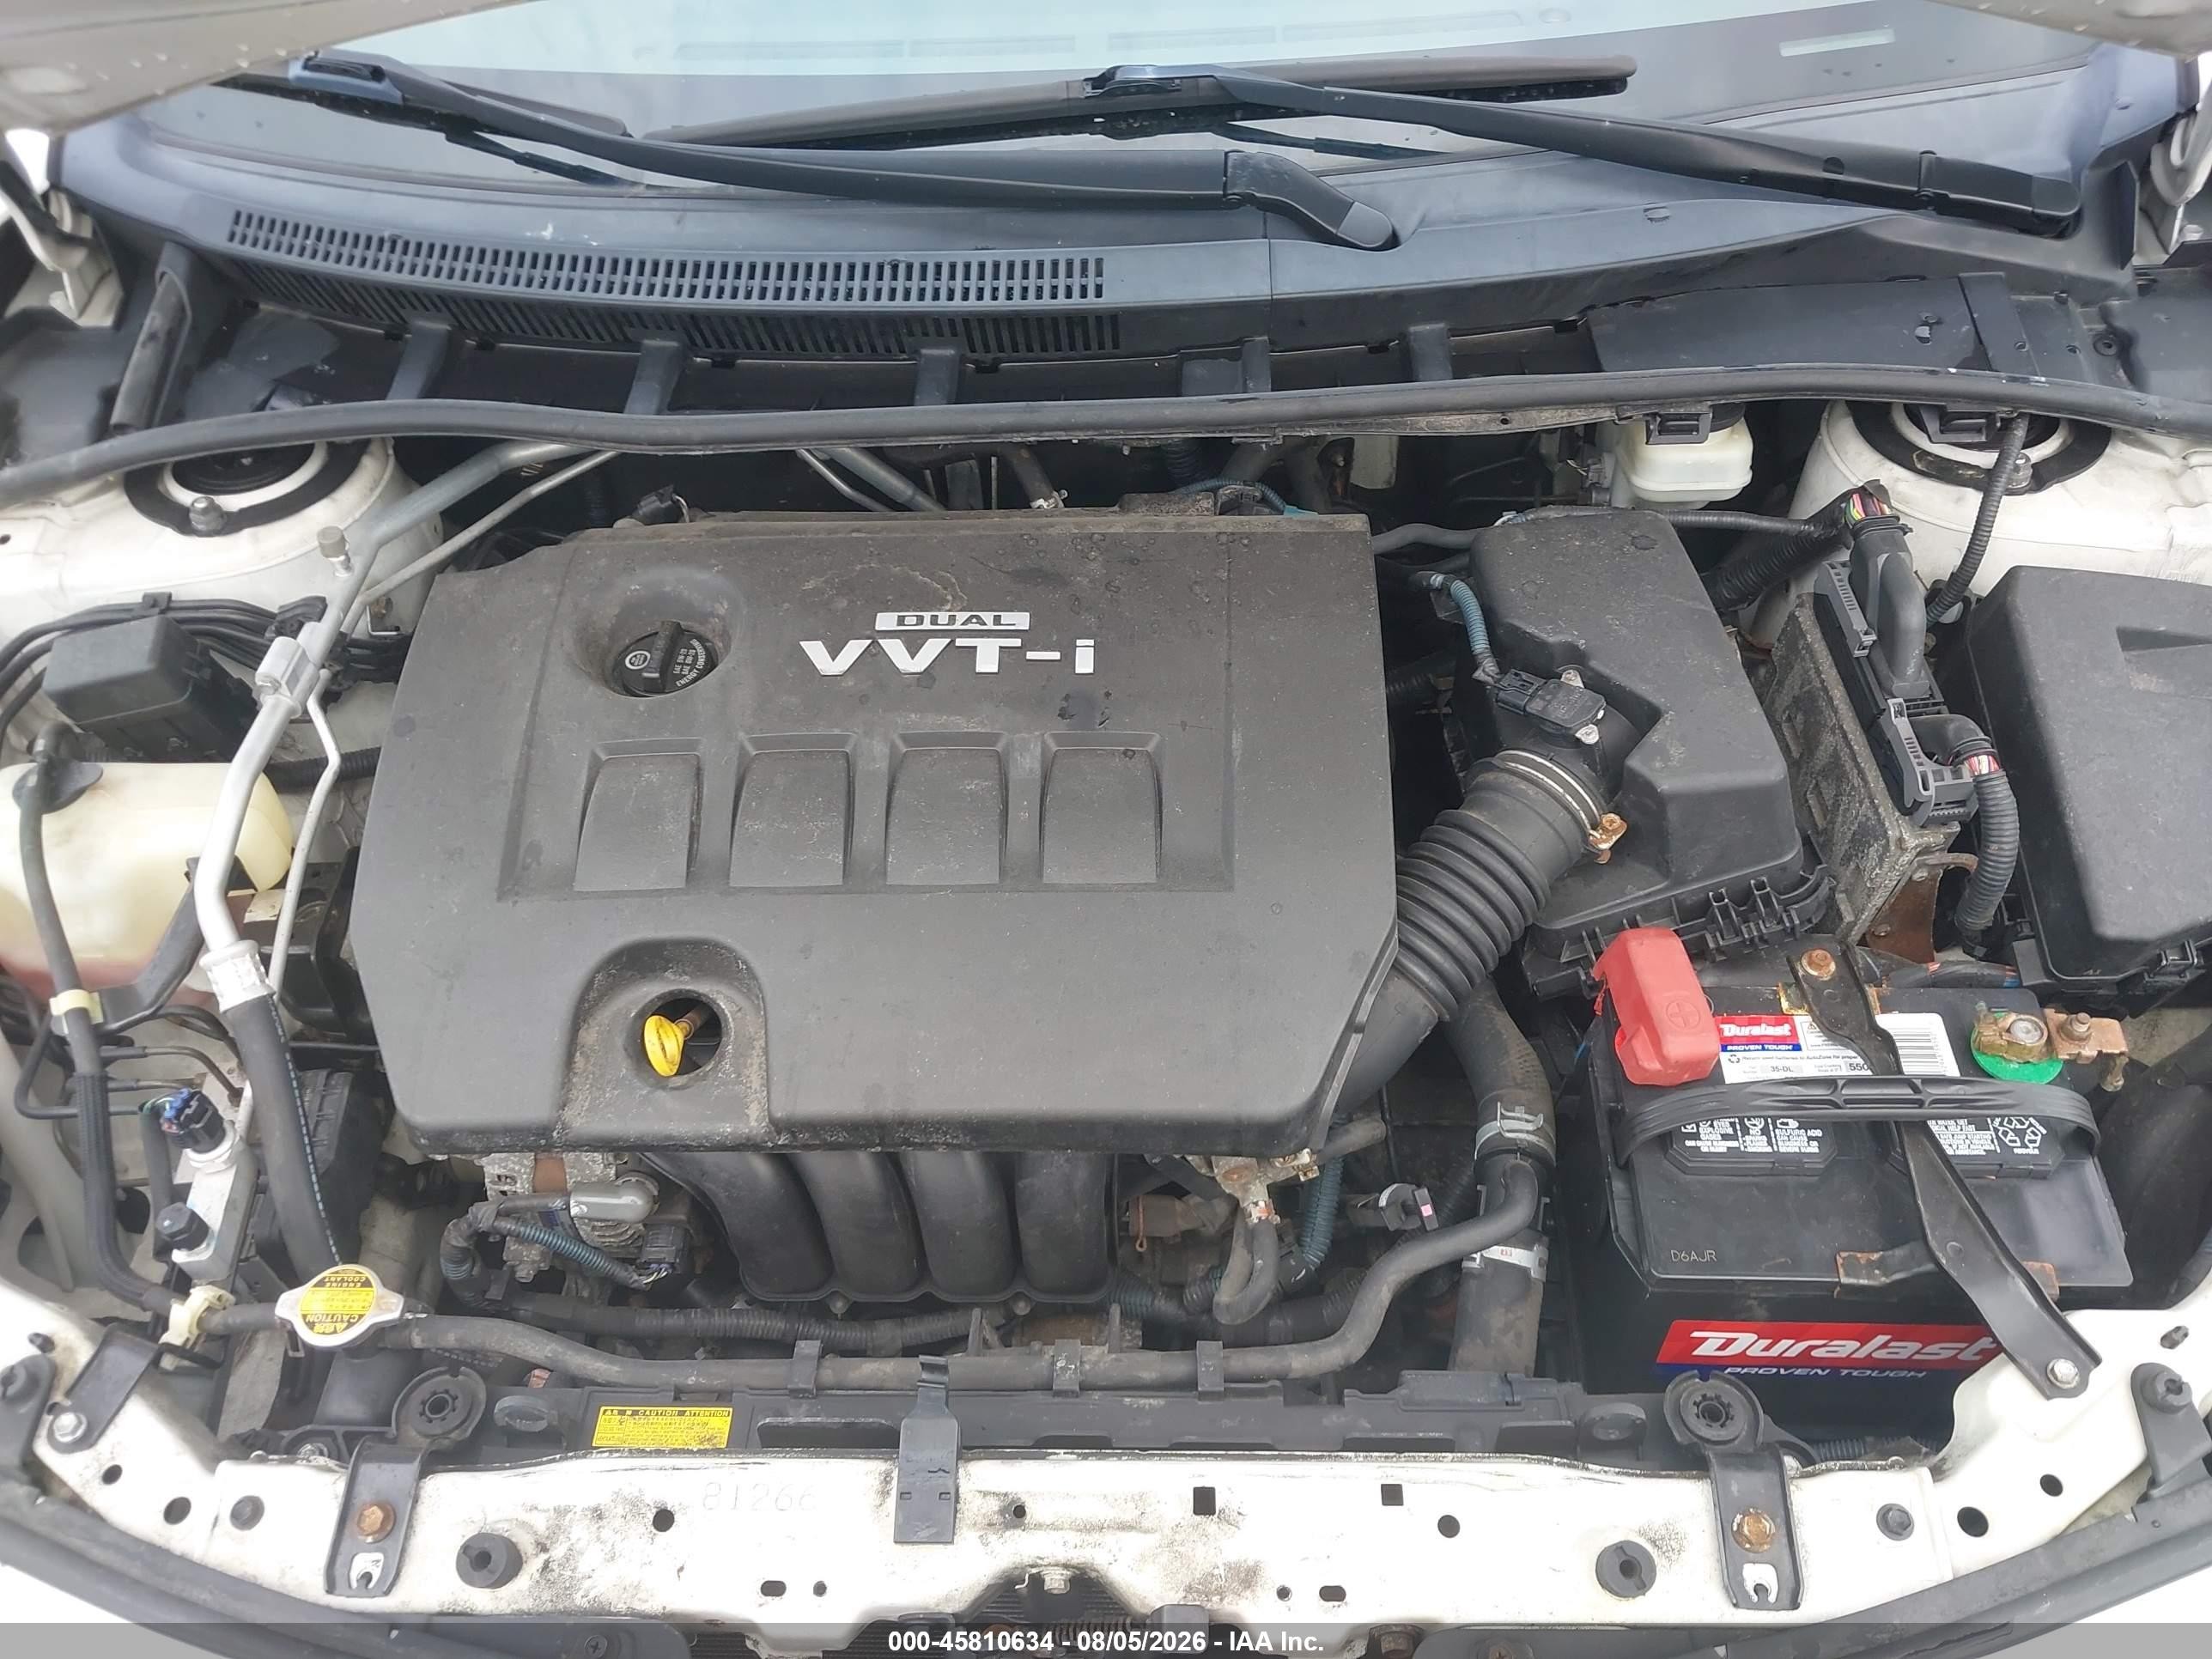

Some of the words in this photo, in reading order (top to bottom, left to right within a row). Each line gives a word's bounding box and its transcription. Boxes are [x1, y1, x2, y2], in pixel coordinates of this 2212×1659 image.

[896, 614, 1017, 627] DUAL
[799, 638, 1095, 676] VVT-i
[675, 668, 700, 687] ENERGY
[1719, 1023, 1793, 1037] Duralast
[1670, 1249, 1717, 1263] D6AJR
[306, 1314, 360, 1322] CAUTION
[1690, 1330, 1997, 1362] Duralast
[1724, 1366, 1830, 1376] PROVEN
[1838, 1368, 1927, 1378] TOUGH
